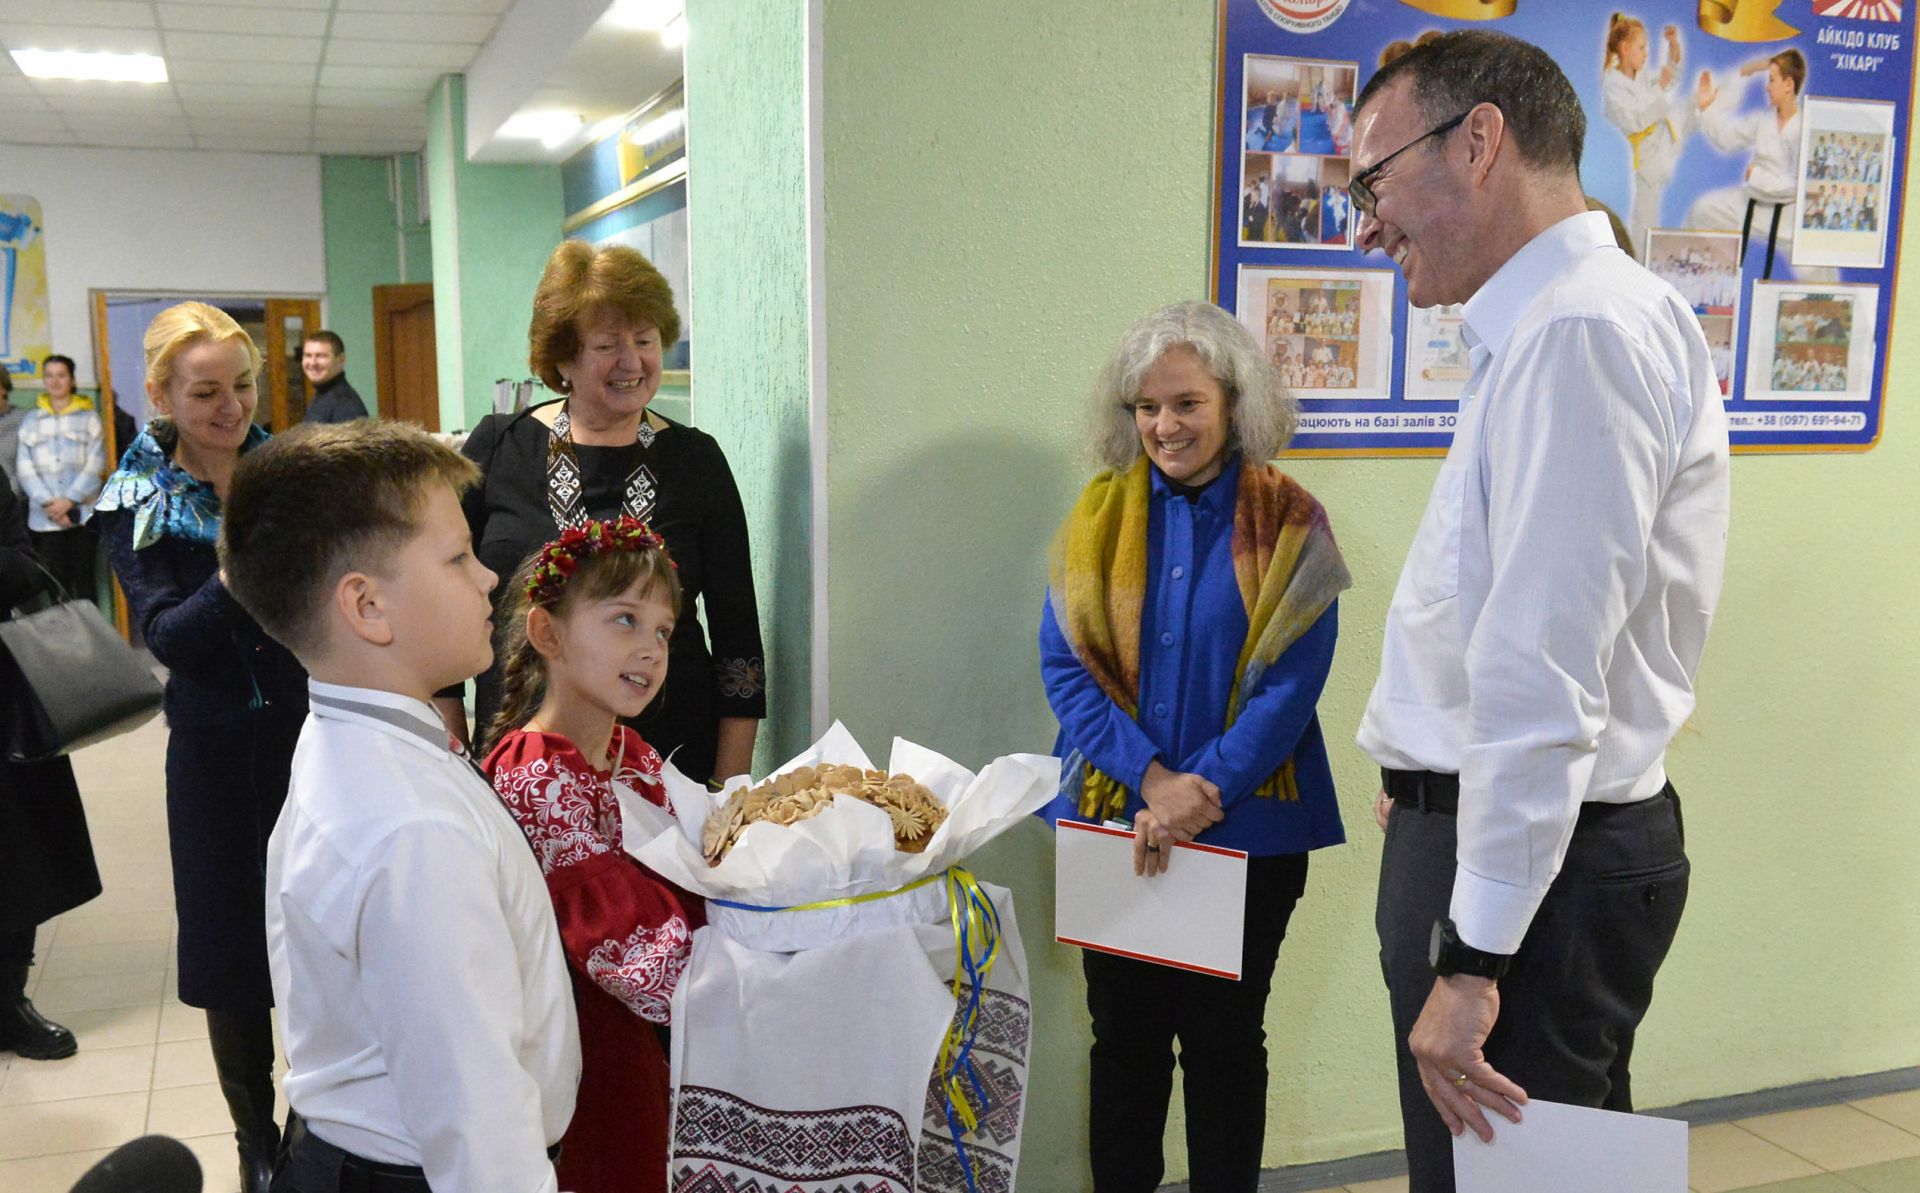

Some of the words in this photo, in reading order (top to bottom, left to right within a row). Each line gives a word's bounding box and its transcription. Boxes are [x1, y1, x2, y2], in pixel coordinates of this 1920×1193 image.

[1816, 25, 1865, 49] АЙКІДО
[1867, 32, 1900, 51] КЛУБ
[1830, 53, 1884, 72] "ХІКАРІ"
[1355, 418, 1370, 427] на
[1374, 415, 1400, 427] базі
[1403, 415, 1435, 427] залів
[1438, 415, 1457, 427] ЗО
[1729, 416, 1754, 426] тел.:
[1757, 415, 1777, 426] +38
[1779, 414, 1809, 428] (097)
[1811, 414, 1862, 426] 691-94-71
